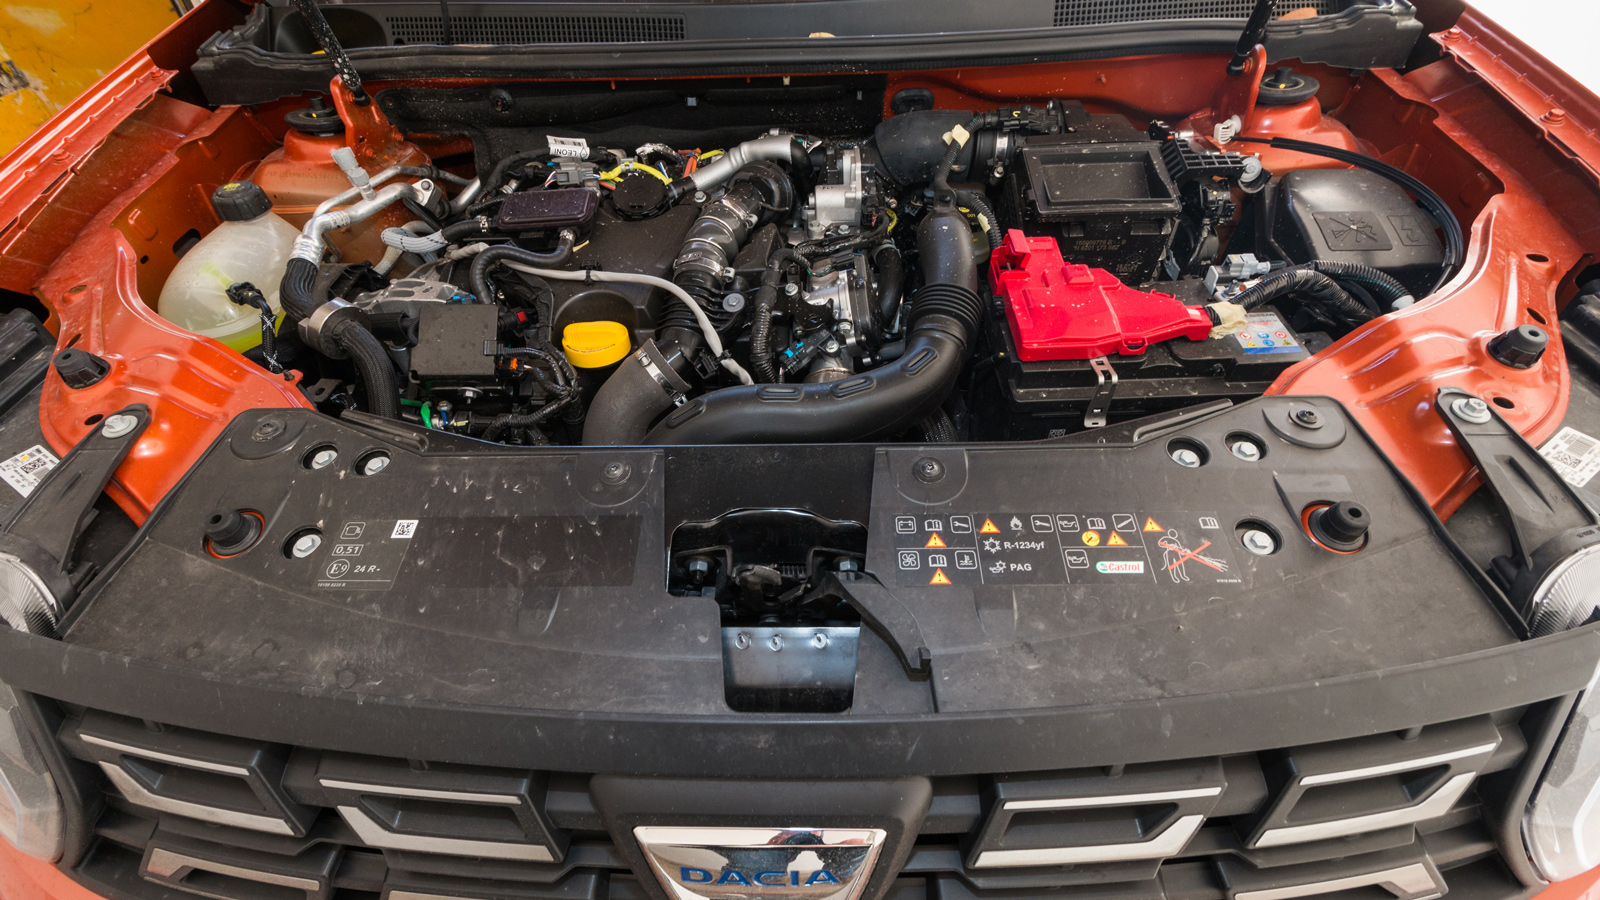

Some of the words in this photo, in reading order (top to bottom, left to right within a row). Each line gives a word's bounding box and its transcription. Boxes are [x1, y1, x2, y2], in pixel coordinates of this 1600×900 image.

[1003, 541, 1045, 550] R-1234yf
[335, 546, 359, 555] 0,51
[329, 563, 347, 574] E9
[354, 565, 366, 573] 24
[1010, 563, 1032, 571] PAG
[1108, 562, 1141, 572] Castrol
[679, 866, 841, 887] DACIA
